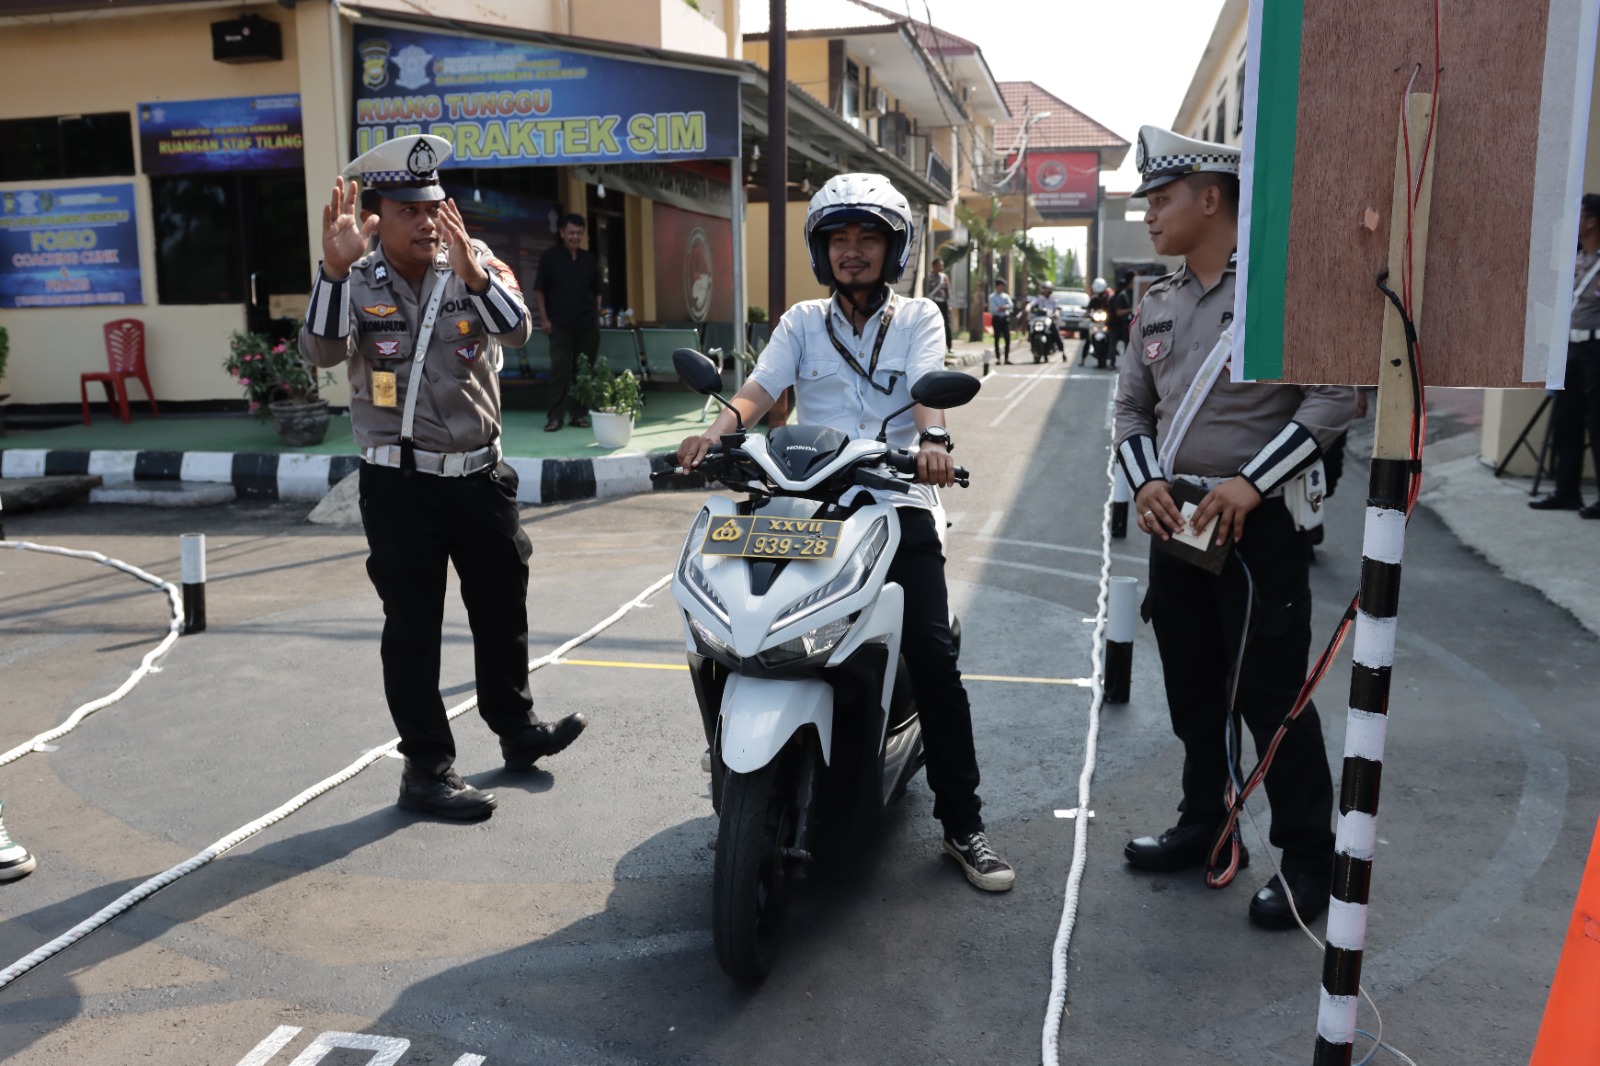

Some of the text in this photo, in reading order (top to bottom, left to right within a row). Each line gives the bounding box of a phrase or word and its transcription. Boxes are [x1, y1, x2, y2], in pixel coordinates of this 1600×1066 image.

[358, 89, 551, 123] RUANG TUNGGU
[158, 134, 302, 155] RUANGAN STAF TILANG
[429, 116, 619, 158] PRAKTEK
[627, 111, 706, 153] SIM
[31, 228, 97, 251] POSKO
[439, 298, 473, 318] POLR
[1142, 320, 1173, 338] AGNES
[786, 445, 818, 453] HONDA
[769, 519, 823, 532] XXVII
[753, 536, 828, 555] 939-28
